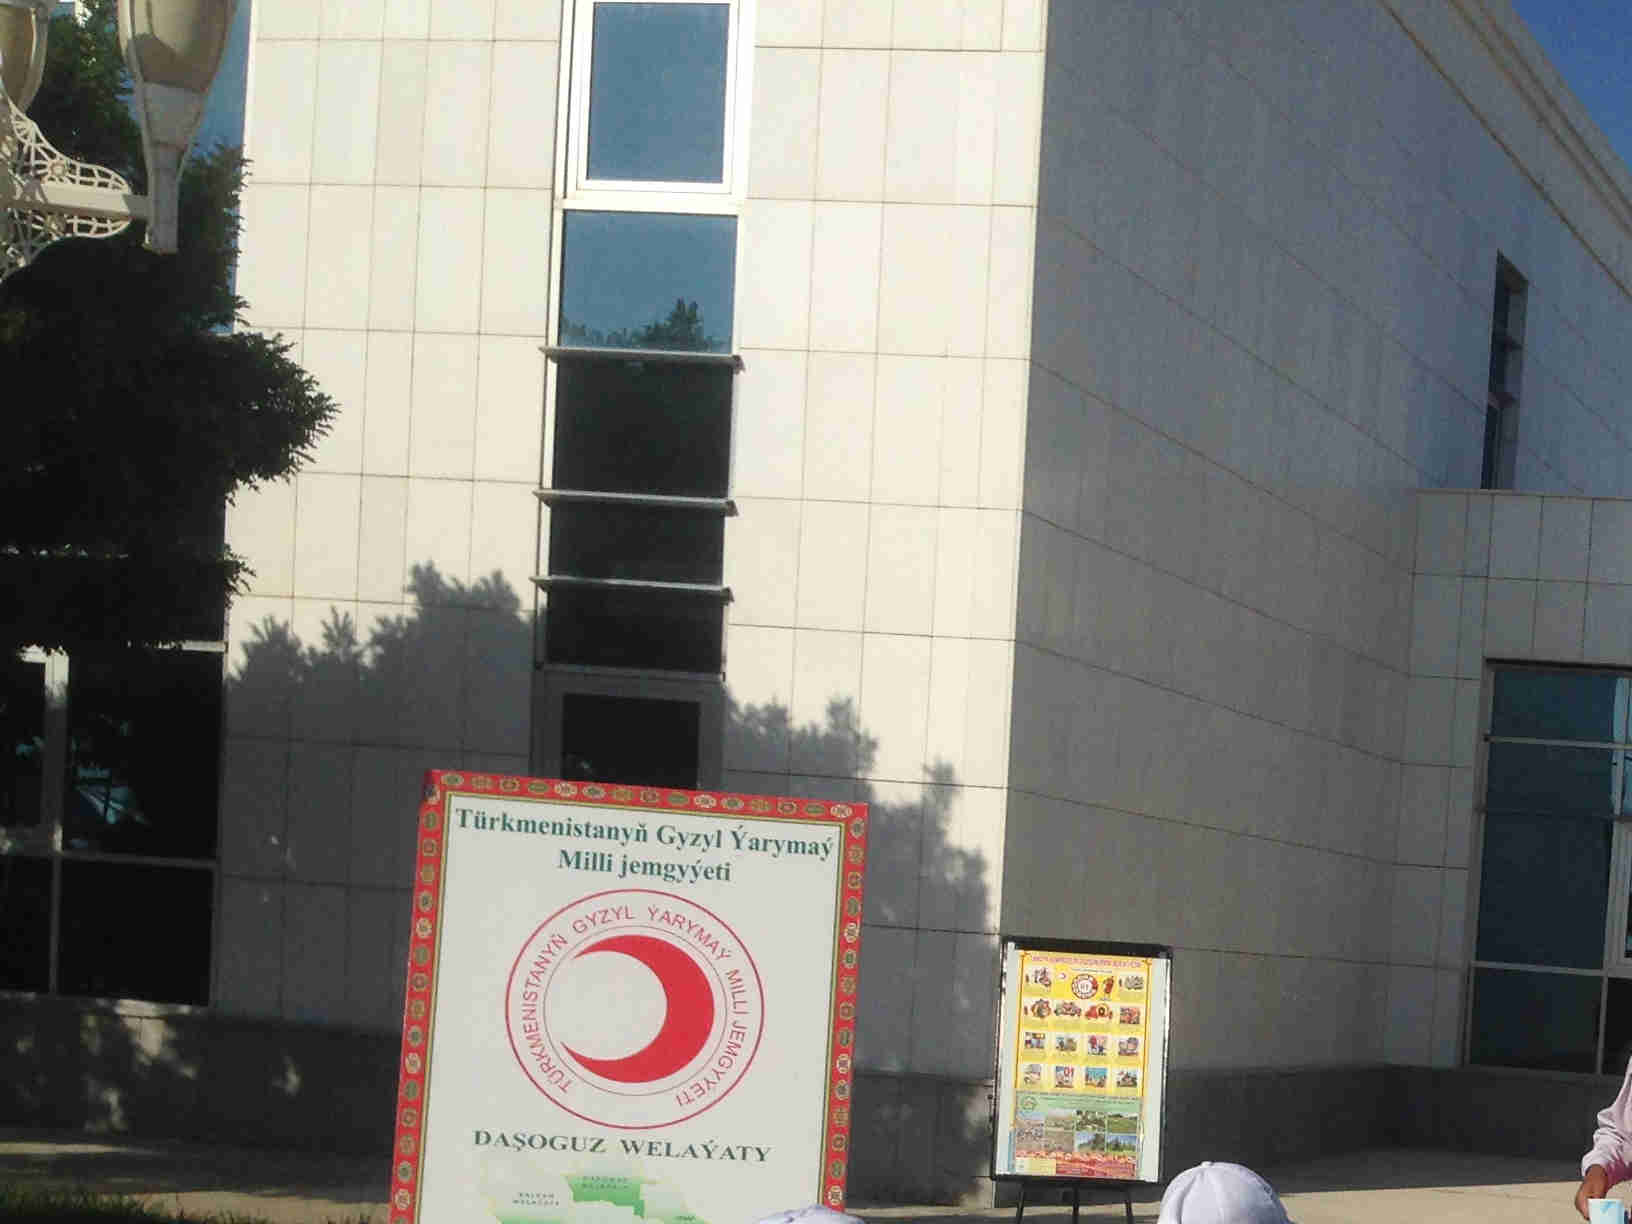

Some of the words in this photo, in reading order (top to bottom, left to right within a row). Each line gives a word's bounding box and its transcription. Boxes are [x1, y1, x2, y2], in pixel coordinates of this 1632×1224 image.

[456, 808, 648, 847] Türkmenistanyň
[656, 825, 723, 853] Gyzyl
[731, 825, 834, 862] Ýarymaý
[557, 849, 613, 873] Milli
[617, 854, 732, 884] jemgyýeti
[572, 904, 635, 935] GYZYL
[726, 968, 750, 1016] MILLI
[473, 1130, 607, 1153] DAŞOGUZ
[620, 1138, 773, 1163] WELAÝATY
